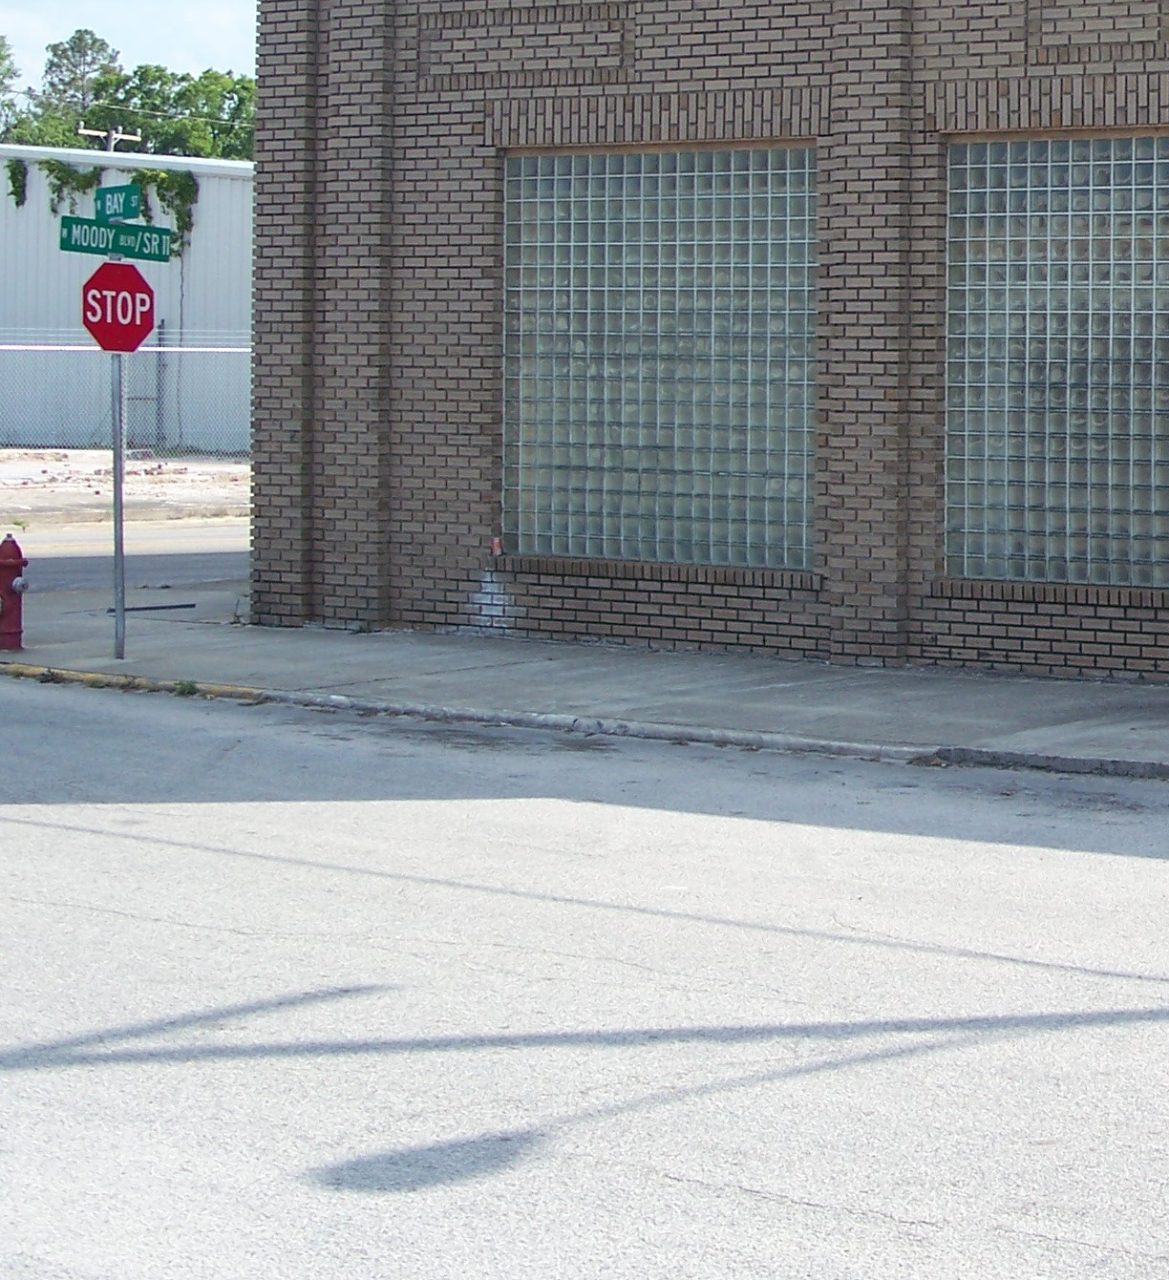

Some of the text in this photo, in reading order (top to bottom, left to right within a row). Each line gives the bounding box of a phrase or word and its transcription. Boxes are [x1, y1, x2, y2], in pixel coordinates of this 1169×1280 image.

[105, 192, 126, 215] BAY
[130, 195, 139, 208] ST
[71, 223, 116, 250] MOODY
[86, 288, 151, 326] STOP
